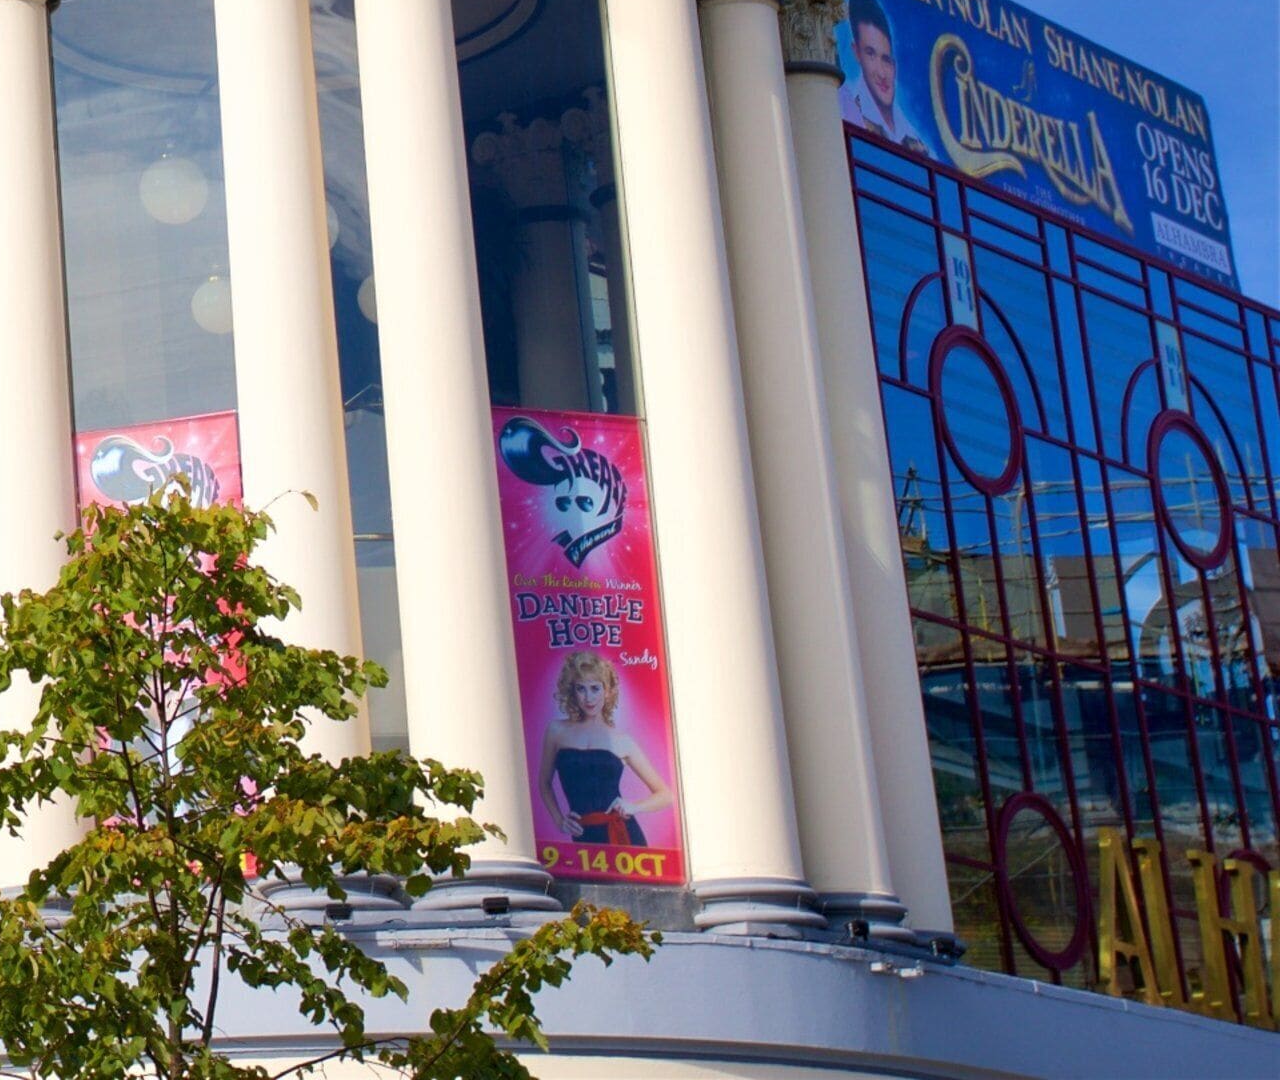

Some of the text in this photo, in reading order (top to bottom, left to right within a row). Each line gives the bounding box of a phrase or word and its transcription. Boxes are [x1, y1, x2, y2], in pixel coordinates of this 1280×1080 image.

[1044, 25, 1124, 101] SHANE
[1125, 66, 1208, 143] NOLAN
[930, 33, 1135, 238] CINDERELLA
[1136, 122, 1215, 190] OPENS
[1143, 162, 1223, 231] 16 DEC
[1157, 222, 1228, 270] ALHAMBRA
[513, 572, 537, 587] Over
[543, 572, 560, 588] The
[605, 578, 643, 591] Winner
[516, 592, 644, 623] DANIELLE
[547, 617, 623, 648] HOPE
[619, 647, 658, 670] Sandy
[542, 846, 559, 869] 9
[577, 849, 609, 873] 14
[615, 851, 666, 877] OCT
[1098, 826, 1280, 1033] ALH
